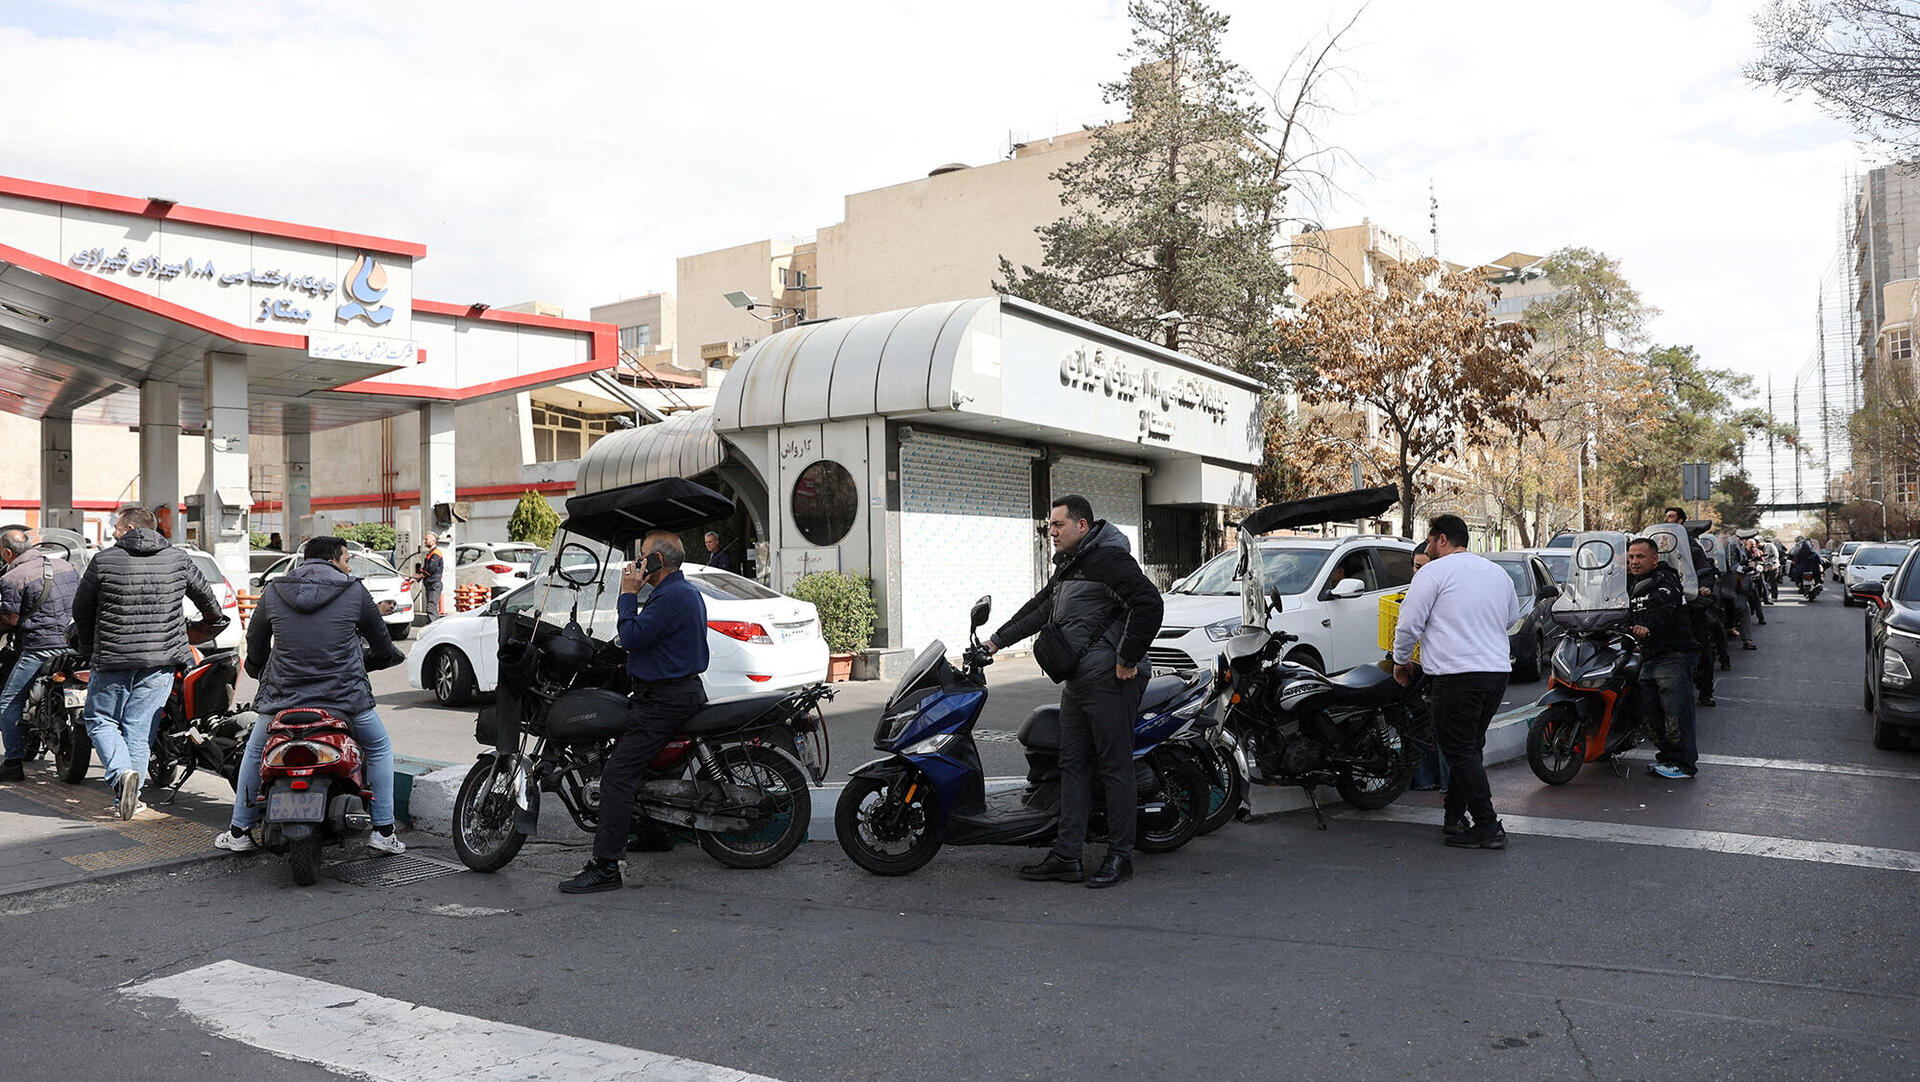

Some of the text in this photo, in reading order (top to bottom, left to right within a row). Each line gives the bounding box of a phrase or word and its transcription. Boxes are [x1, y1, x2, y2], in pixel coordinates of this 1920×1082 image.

[68, 246, 130, 274] شیرازی
[128, 253, 183, 281] میرزای
[217, 267, 291, 289] اختصاصی
[290, 275, 337, 300] جایگاه
[256, 297, 312, 324] ممتاز
